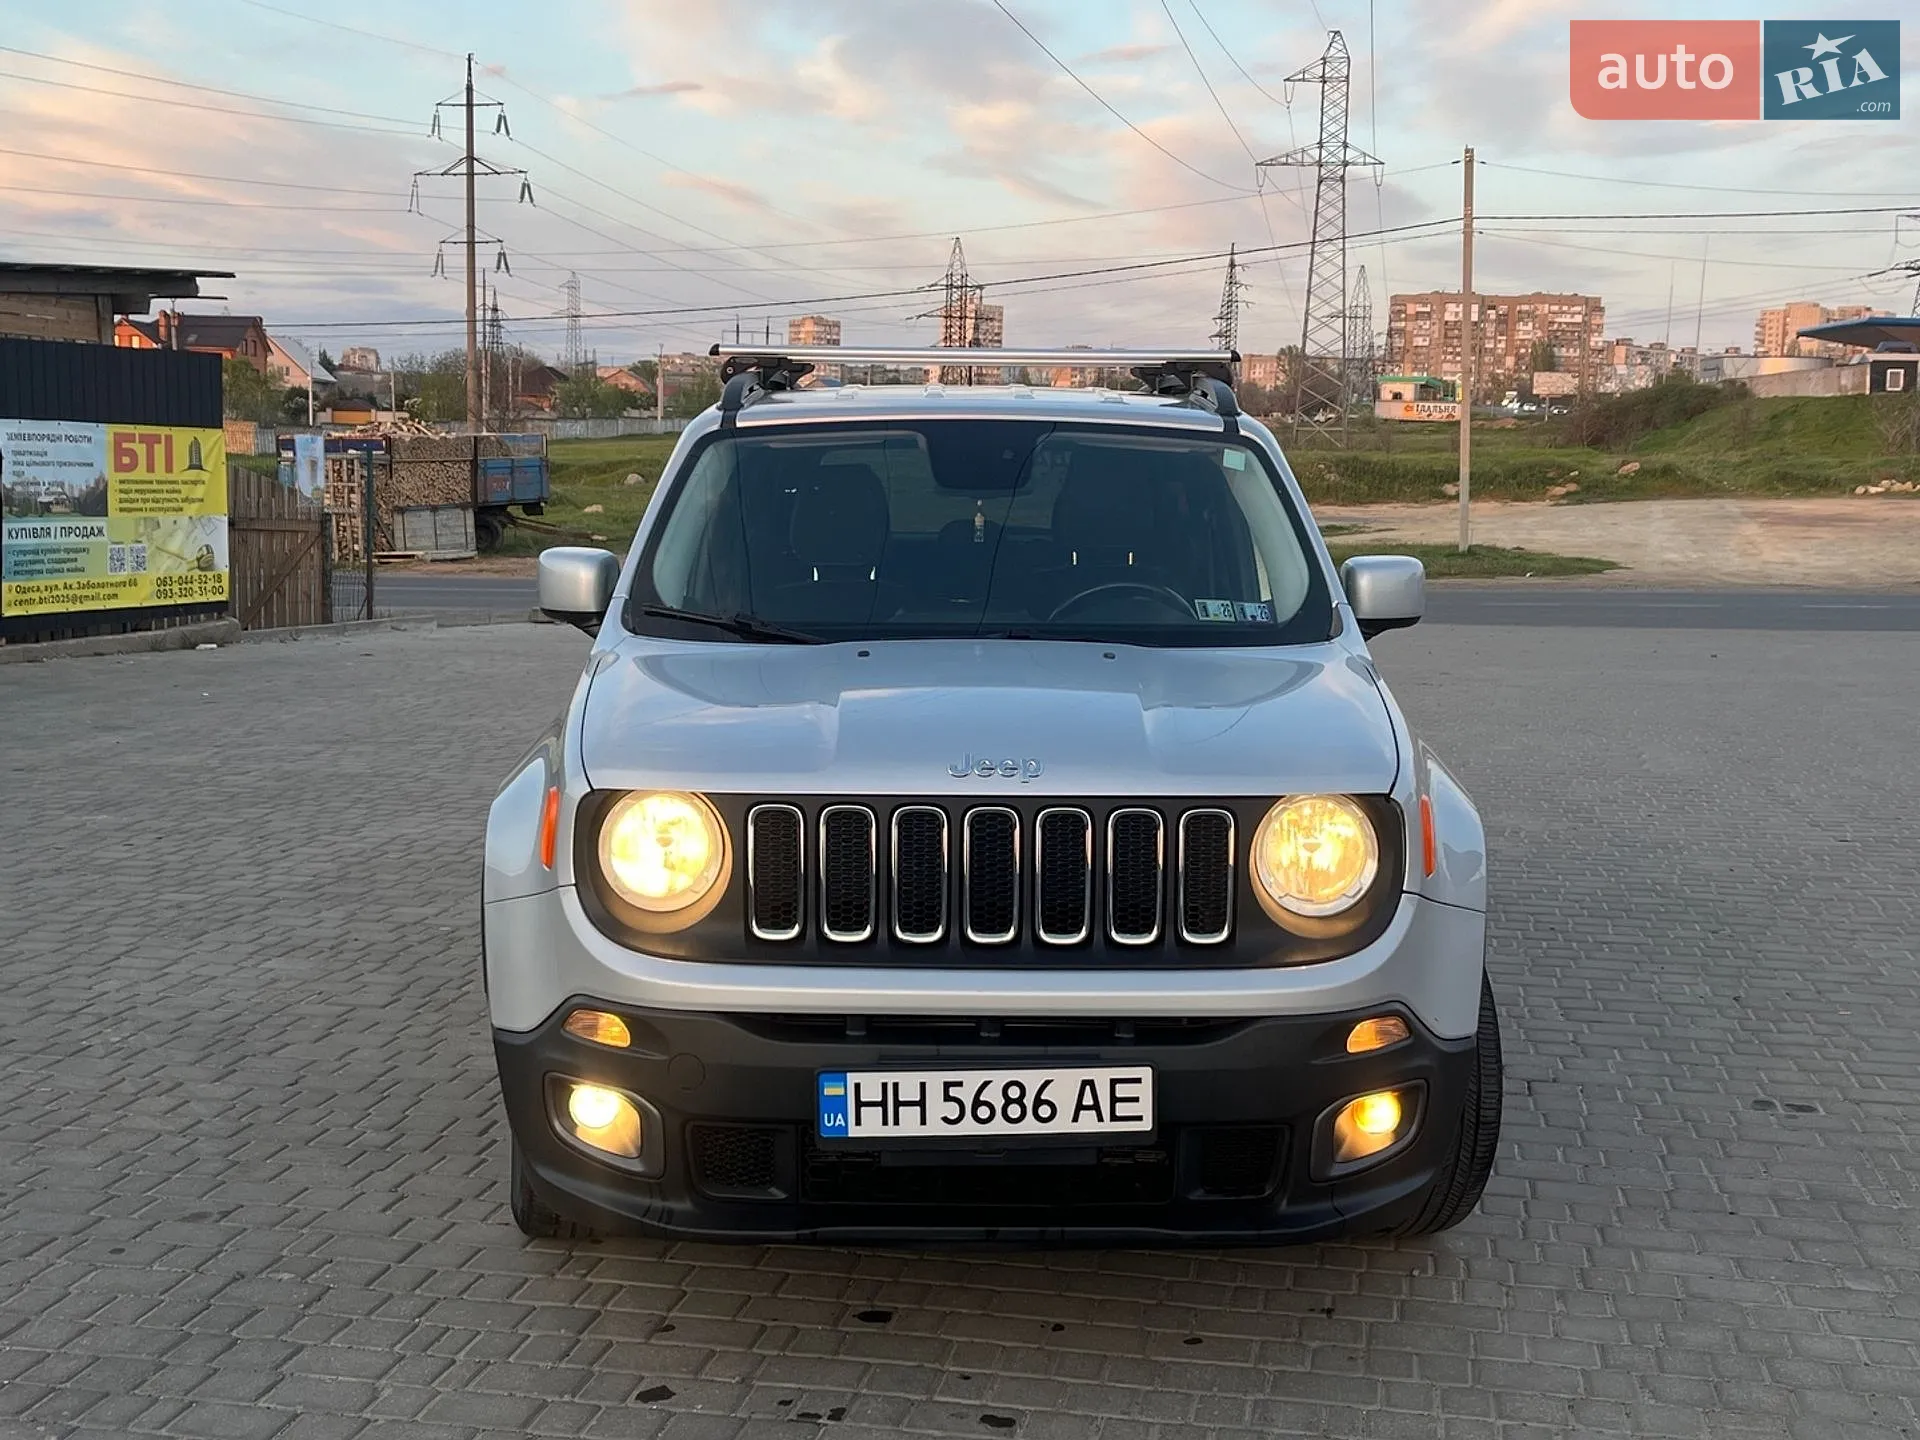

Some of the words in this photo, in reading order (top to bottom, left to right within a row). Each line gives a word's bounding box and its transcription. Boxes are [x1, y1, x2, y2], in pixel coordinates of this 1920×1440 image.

[113, 432, 174, 473] БТІ
[8, 527, 52, 539] КУПІВЛЯ
[60, 526, 105, 539] ПРОДАЖ
[947, 752, 1042, 783] Jeep
[854, 1081, 927, 1126] HH
[940, 1079, 1058, 1125] 5686
[1071, 1077, 1144, 1123] AE
[824, 1113, 846, 1127] UA
